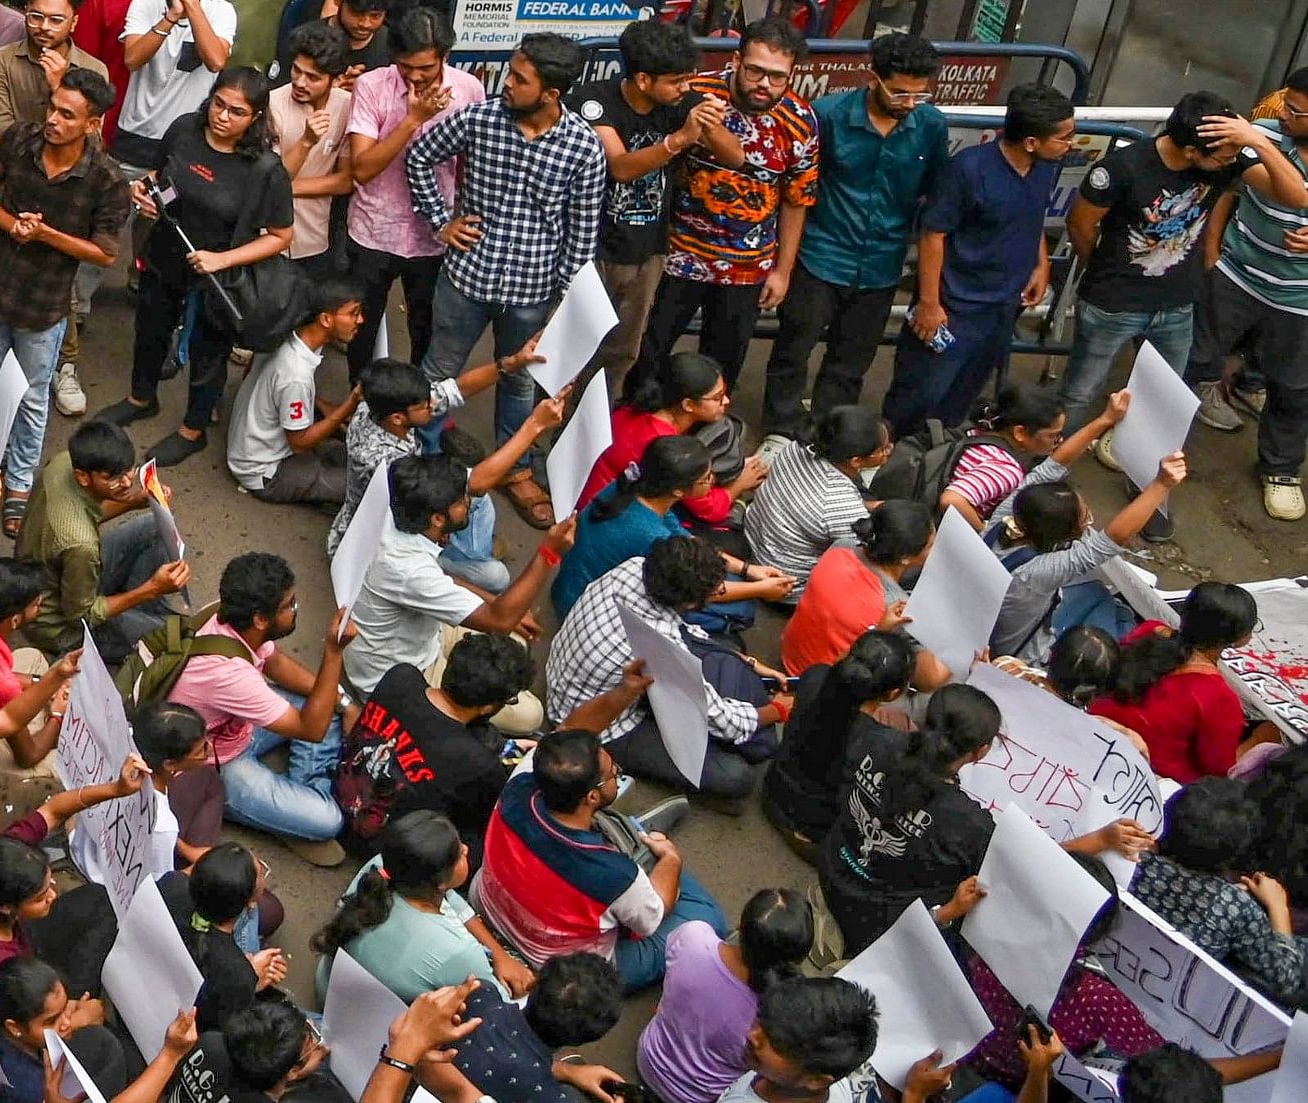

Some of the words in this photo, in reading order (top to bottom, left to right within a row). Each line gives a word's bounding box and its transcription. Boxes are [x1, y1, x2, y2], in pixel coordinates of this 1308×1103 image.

[465, 2, 513, 13] HORMIS
[523, 1, 586, 16] FEDERAL
[464, 13, 510, 21] MEMORIAL
[462, 21, 510, 29] FOUNDATION
[461, 33, 470, 43] A
[472, 32, 518, 43] Federal
[938, 64, 997, 81] KOLKATA
[934, 83, 988, 99] TRAFFIC
[289, 402, 305, 421] 3
